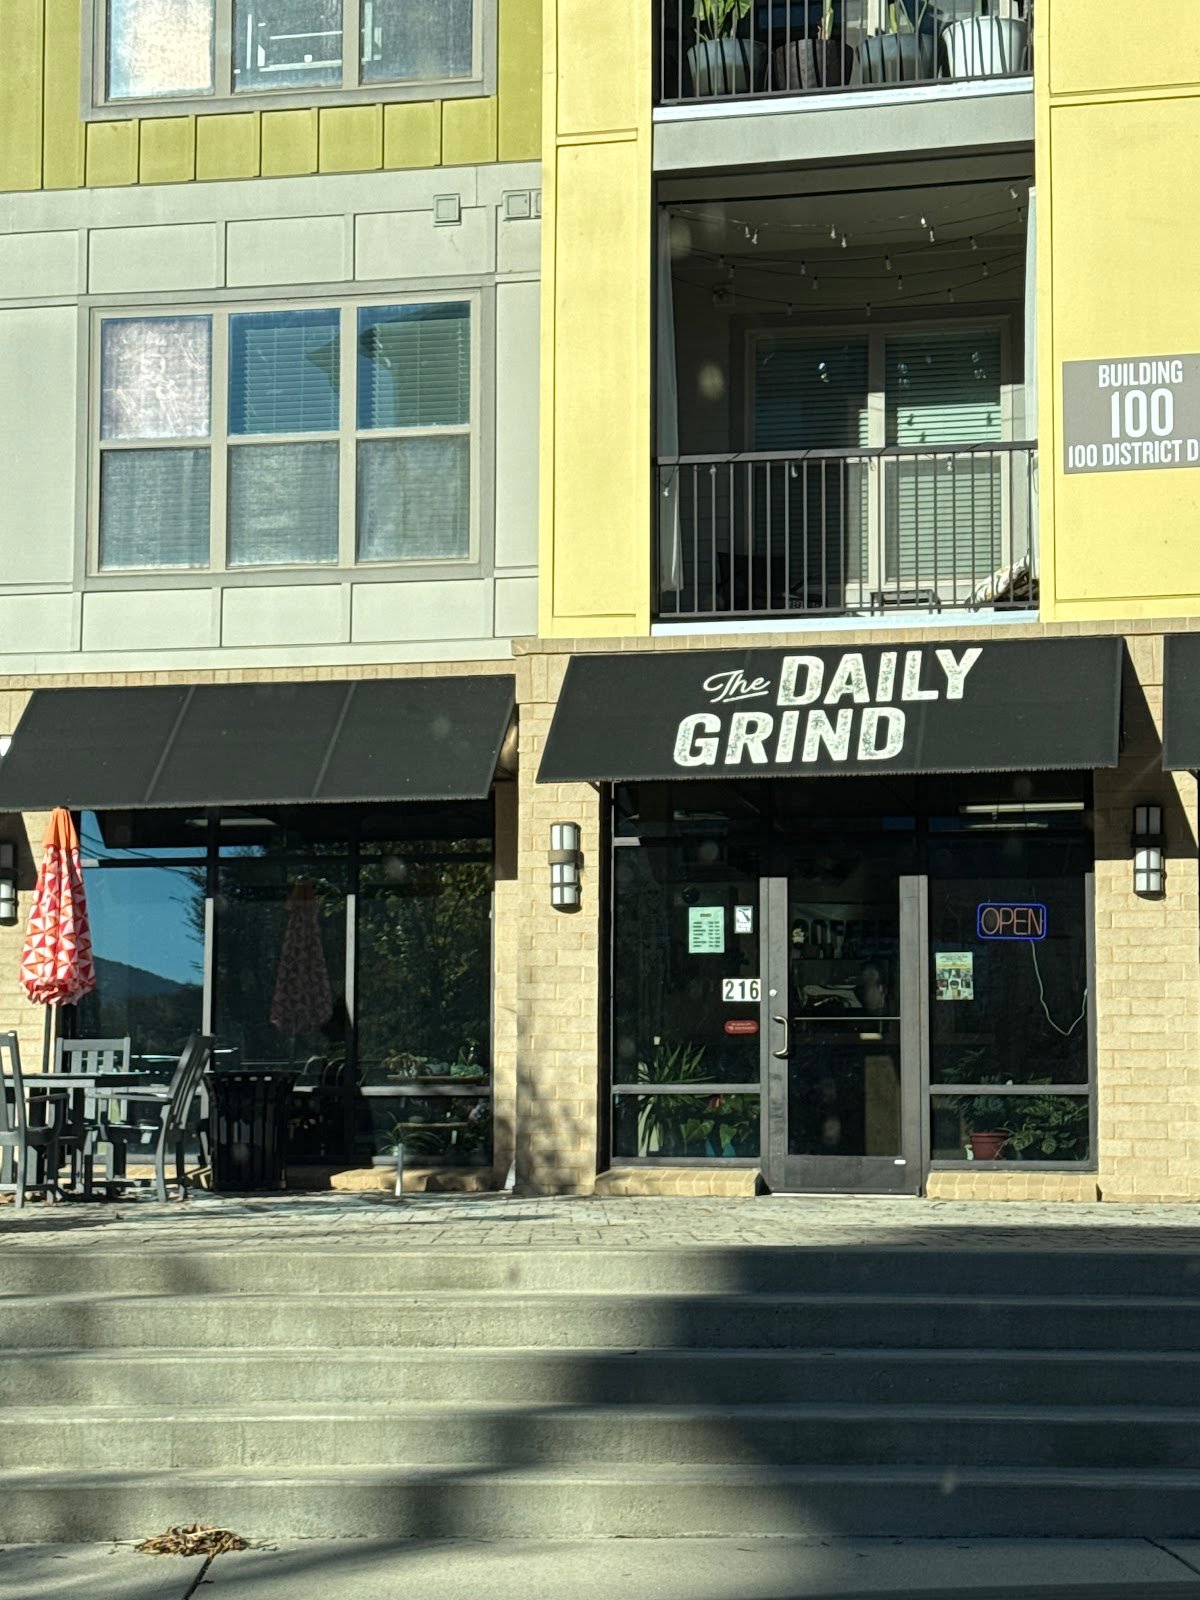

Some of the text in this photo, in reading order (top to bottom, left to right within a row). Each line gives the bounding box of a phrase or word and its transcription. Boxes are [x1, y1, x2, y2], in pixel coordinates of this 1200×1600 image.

[1098, 360, 1183, 388] BUILDING
[1111, 388, 1174, 438] 100
[1068, 444, 1098, 468] 100
[1102, 440, 1183, 466] DISTRICT
[703, 648, 983, 706] The DAILY
[673, 706, 906, 767] GRIND
[981, 907, 1043, 935] OPEN
[725, 980, 760, 1000] 216
